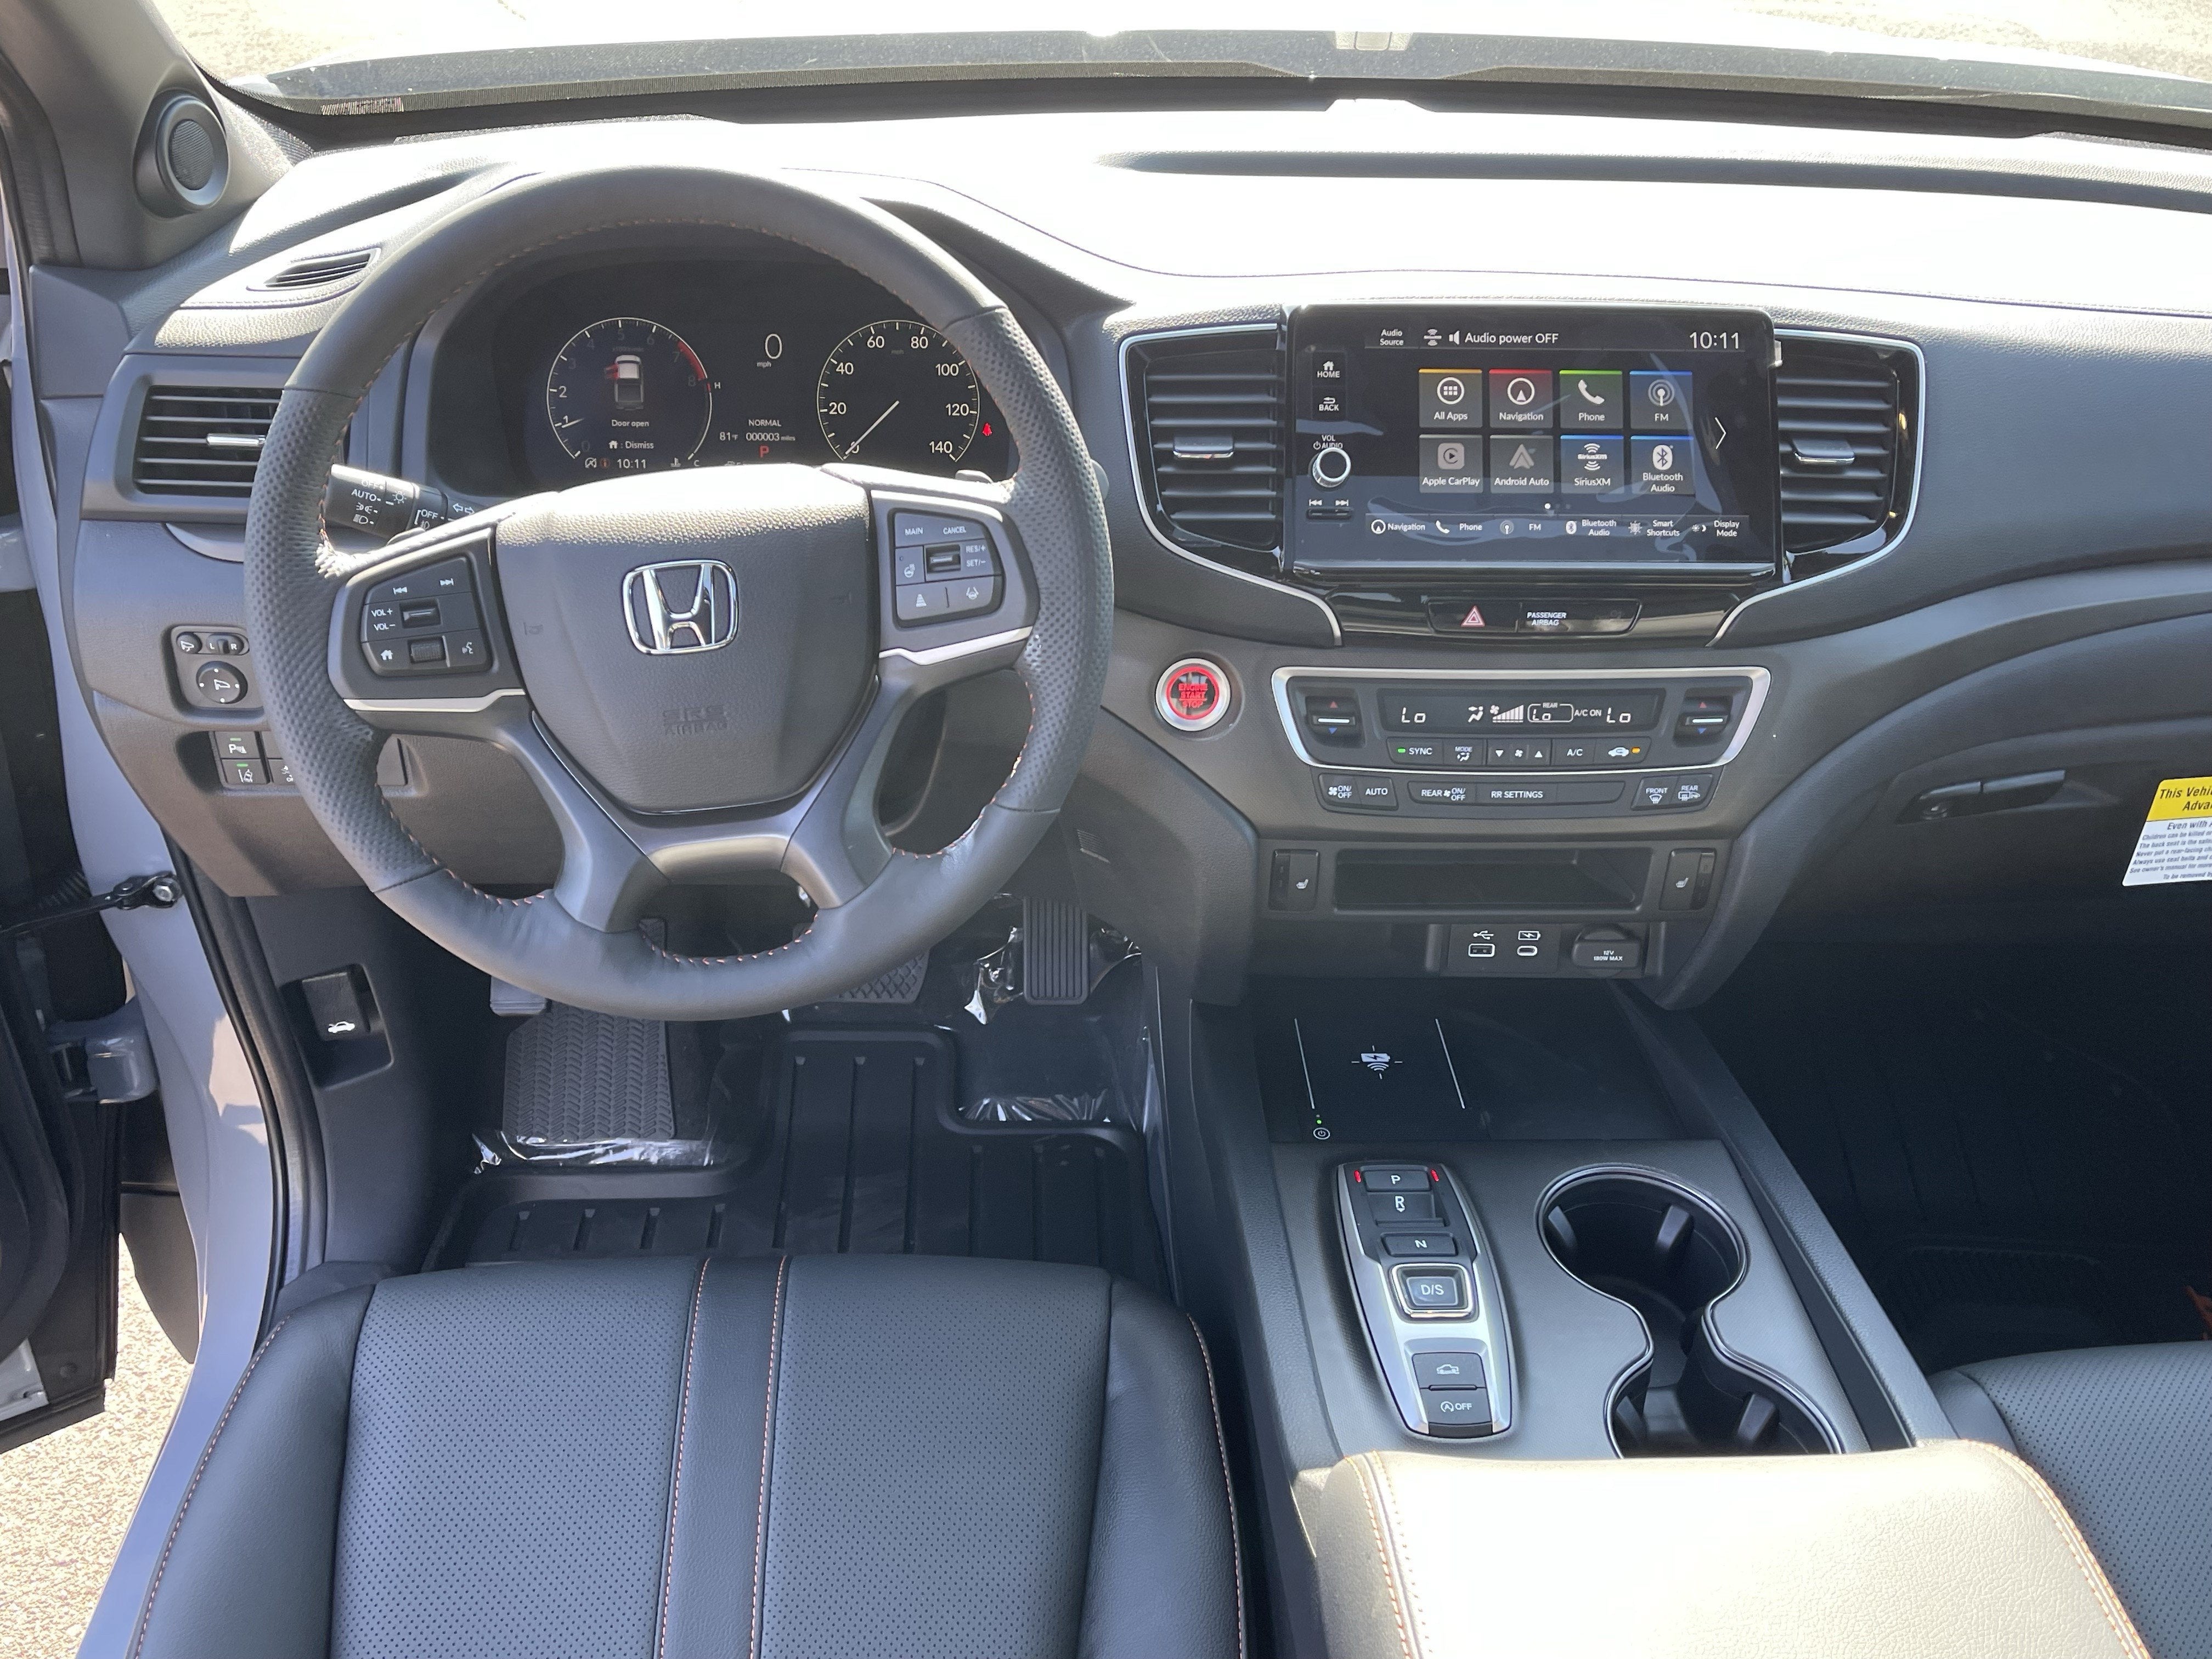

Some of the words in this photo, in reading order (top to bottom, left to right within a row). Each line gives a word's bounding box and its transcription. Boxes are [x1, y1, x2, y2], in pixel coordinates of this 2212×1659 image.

[1381, 329, 1402, 337] Audio
[867, 336, 885, 348] 60
[910, 336, 929, 349] 80
[1465, 333, 1496, 343] Audio
[1499, 334, 1531, 345] power
[1535, 334, 1559, 344] OFF
[1690, 332, 1739, 349] 10:11
[765, 333, 782, 359] 0
[836, 362, 854, 375] 40
[935, 363, 959, 376] 100
[559, 386, 567, 398] 2
[829, 402, 847, 415] 20
[945, 404, 969, 416] 120
[563, 415, 568, 424] 1
[1434, 411, 1446, 420] All
[1447, 413, 1468, 421] Apps
[1499, 412, 1544, 421] Navigation
[1578, 413, 1605, 421] Phone
[746, 433, 780, 441] 000003
[625, 441, 654, 449] Dismiss
[929, 441, 952, 453] 140
[759, 445, 769, 458] P
[617, 459, 646, 469] 10:11
[1422, 477, 1446, 487] Apple
[1448, 477, 1480, 486] CarPlay
[1494, 477, 1527, 486] Android
[1574, 478, 1611, 486] SiriusXM
[1643, 473, 1683, 482] Bluetooth
[352, 489, 376, 501] AUTO
[421, 510, 438, 519] OFF
[1387, 523, 1425, 531] Navigation
[1714, 520, 1740, 529] Display
[943, 526, 967, 534] CANCEL
[1588, 528, 1610, 537] Audio
[229, 744, 236, 753] P
[1567, 748, 1583, 757] A/C
[1504, 791, 1543, 799] SETTINGS
[2159, 788, 2182, 799] This
[1391, 1175, 1401, 1184] P
[1395, 1196, 1404, 1208] R
[1415, 1240, 1427, 1248] N
[1421, 1284, 1444, 1295] D/S
[1455, 1402, 1472, 1410] OFF
